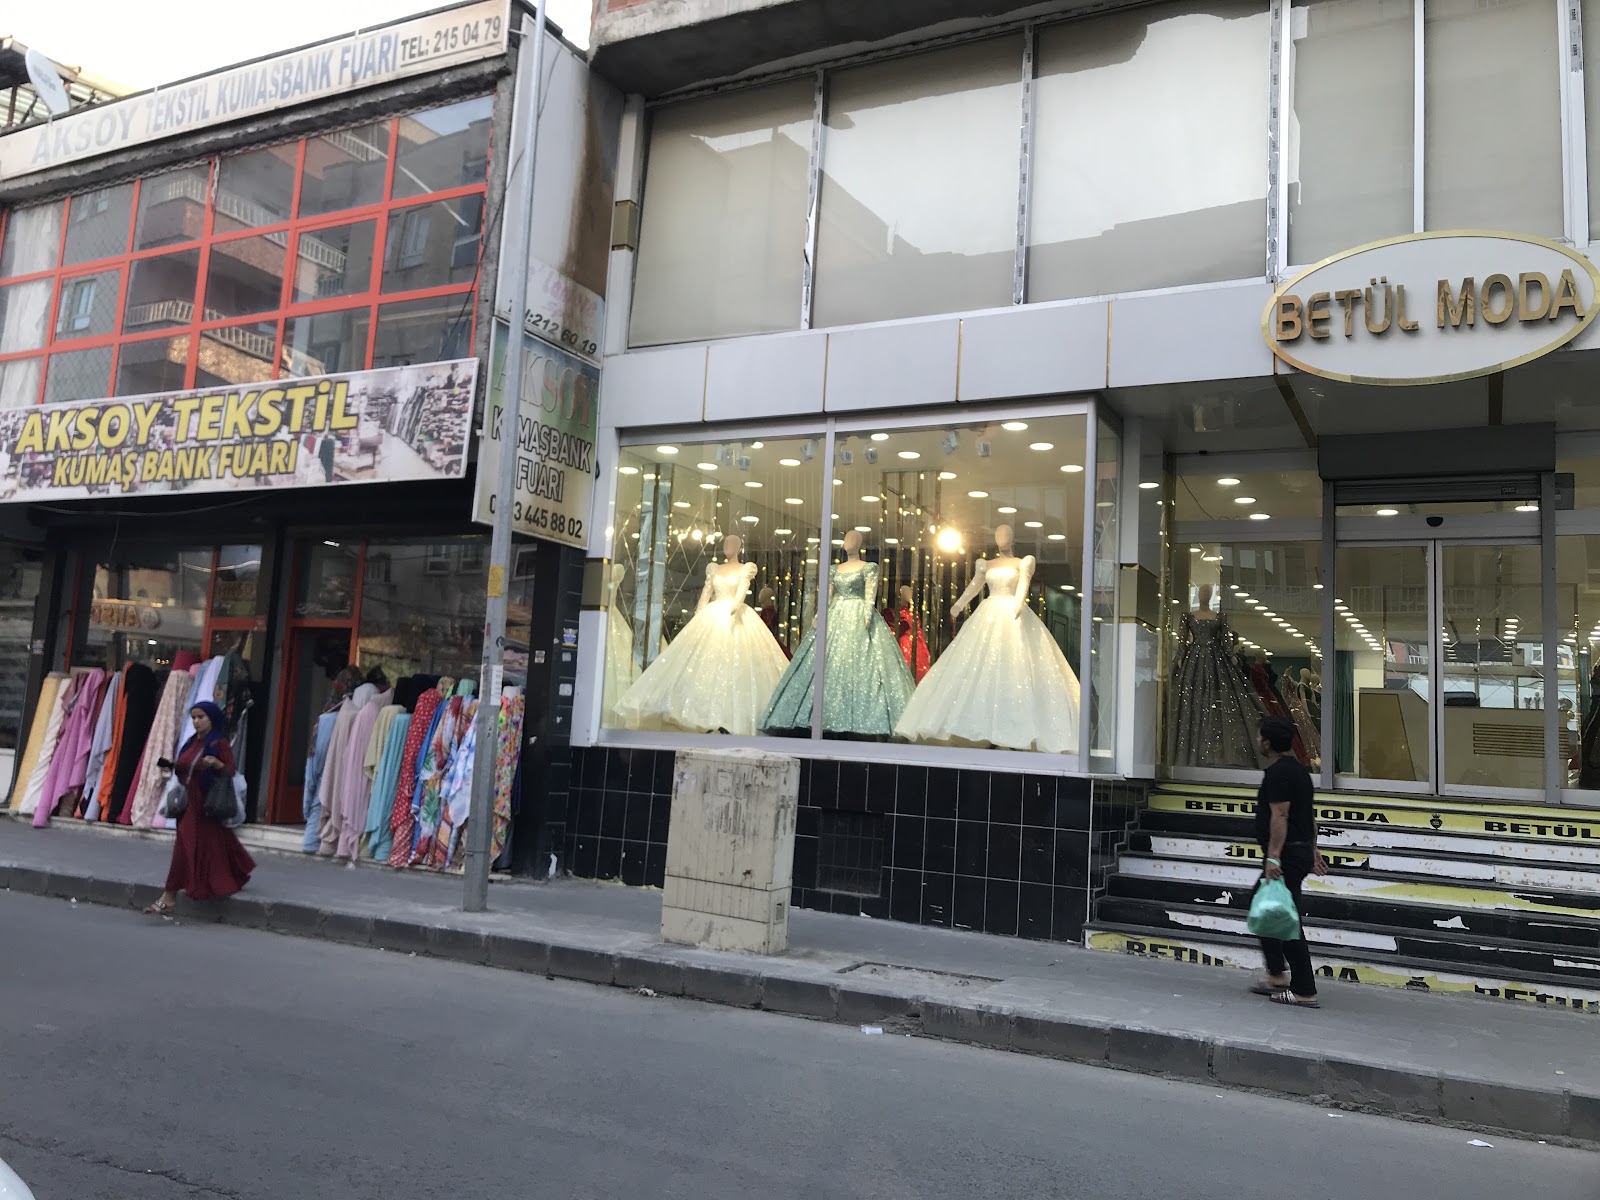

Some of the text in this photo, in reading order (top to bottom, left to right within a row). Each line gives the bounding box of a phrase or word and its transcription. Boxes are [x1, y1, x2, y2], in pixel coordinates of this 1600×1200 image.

[32, 105, 140, 163] AKSOY
[338, 33, 399, 85] FUARI
[401, 36, 430, 61] TEL:
[433, 25, 459, 53] 215
[463, 21, 479, 46] 04
[484, 15, 501, 41] 79
[1276, 268, 1586, 342] BETÜL MODA
[582, 339, 598, 356] 19
[493, 346, 599, 429] KSOY
[15, 402, 162, 455] AKSOY
[490, 404, 593, 474] KMAŞBANK
[53, 438, 298, 492] KUMAŞ BANK FUARI
[515, 455, 565, 503] FUARI
[524, 505, 549, 529] 445
[550, 512, 566, 534] 88
[567, 517, 584, 539] 02
[1184, 800, 1257, 814] BETÜ
[1313, 808, 1390, 824] ODA
